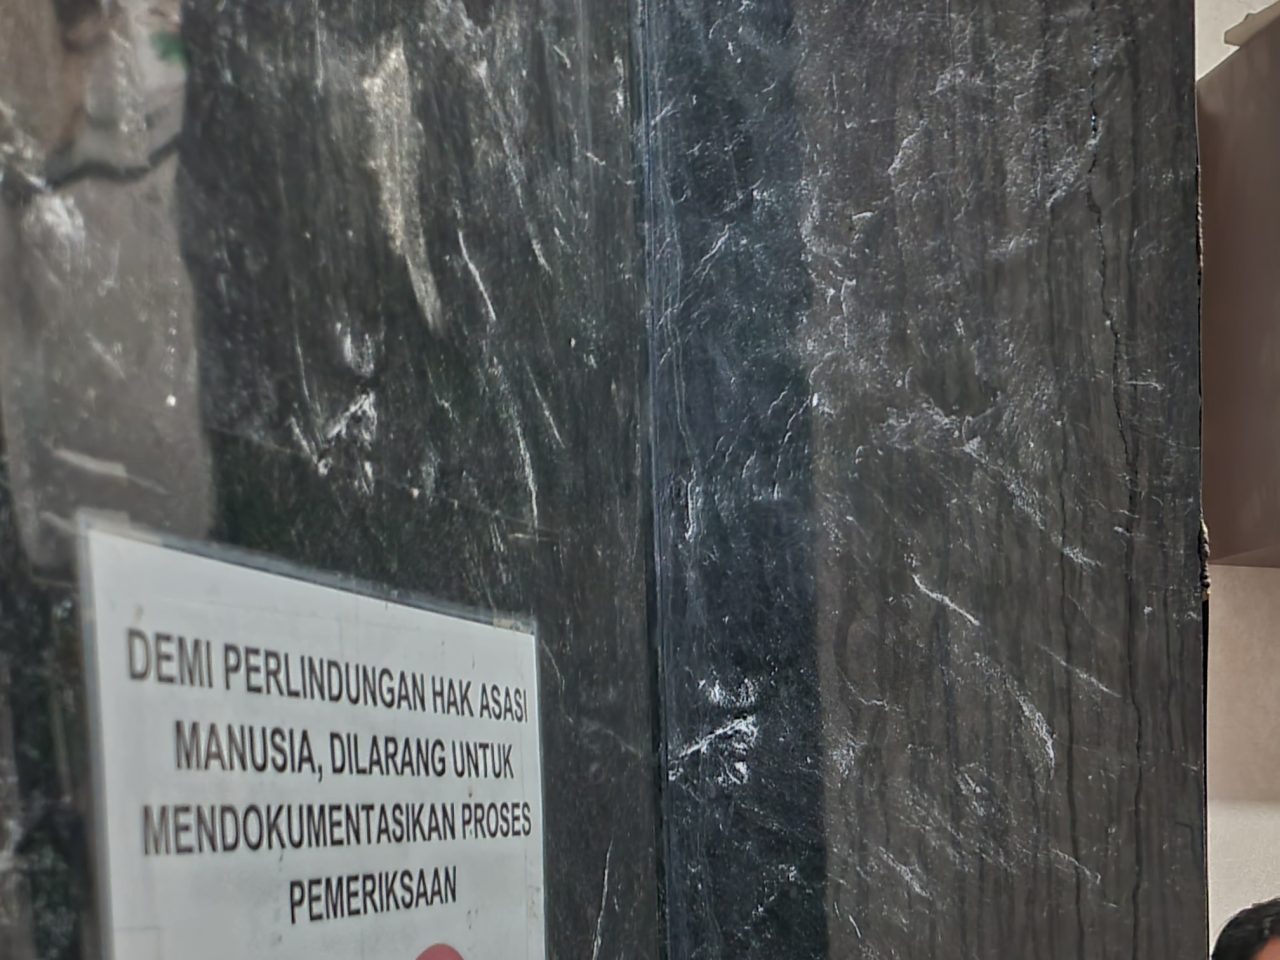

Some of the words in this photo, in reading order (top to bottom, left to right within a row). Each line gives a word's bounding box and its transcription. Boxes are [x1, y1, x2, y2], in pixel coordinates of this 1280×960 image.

[126, 627, 214, 688] DEMI
[223, 643, 427, 713] PERLINDUNGAN
[432, 676, 475, 718] HAK
[479, 683, 529, 724] ASASI
[174, 719, 324, 783] MANUSIA,
[330, 732, 447, 777] DILARANG
[453, 739, 515, 780] UNTUK
[142, 801, 457, 857] MENDOKUMENTASIKAN
[461, 800, 533, 840] PROSES
[289, 865, 458, 925] PEMERIKSAAN
